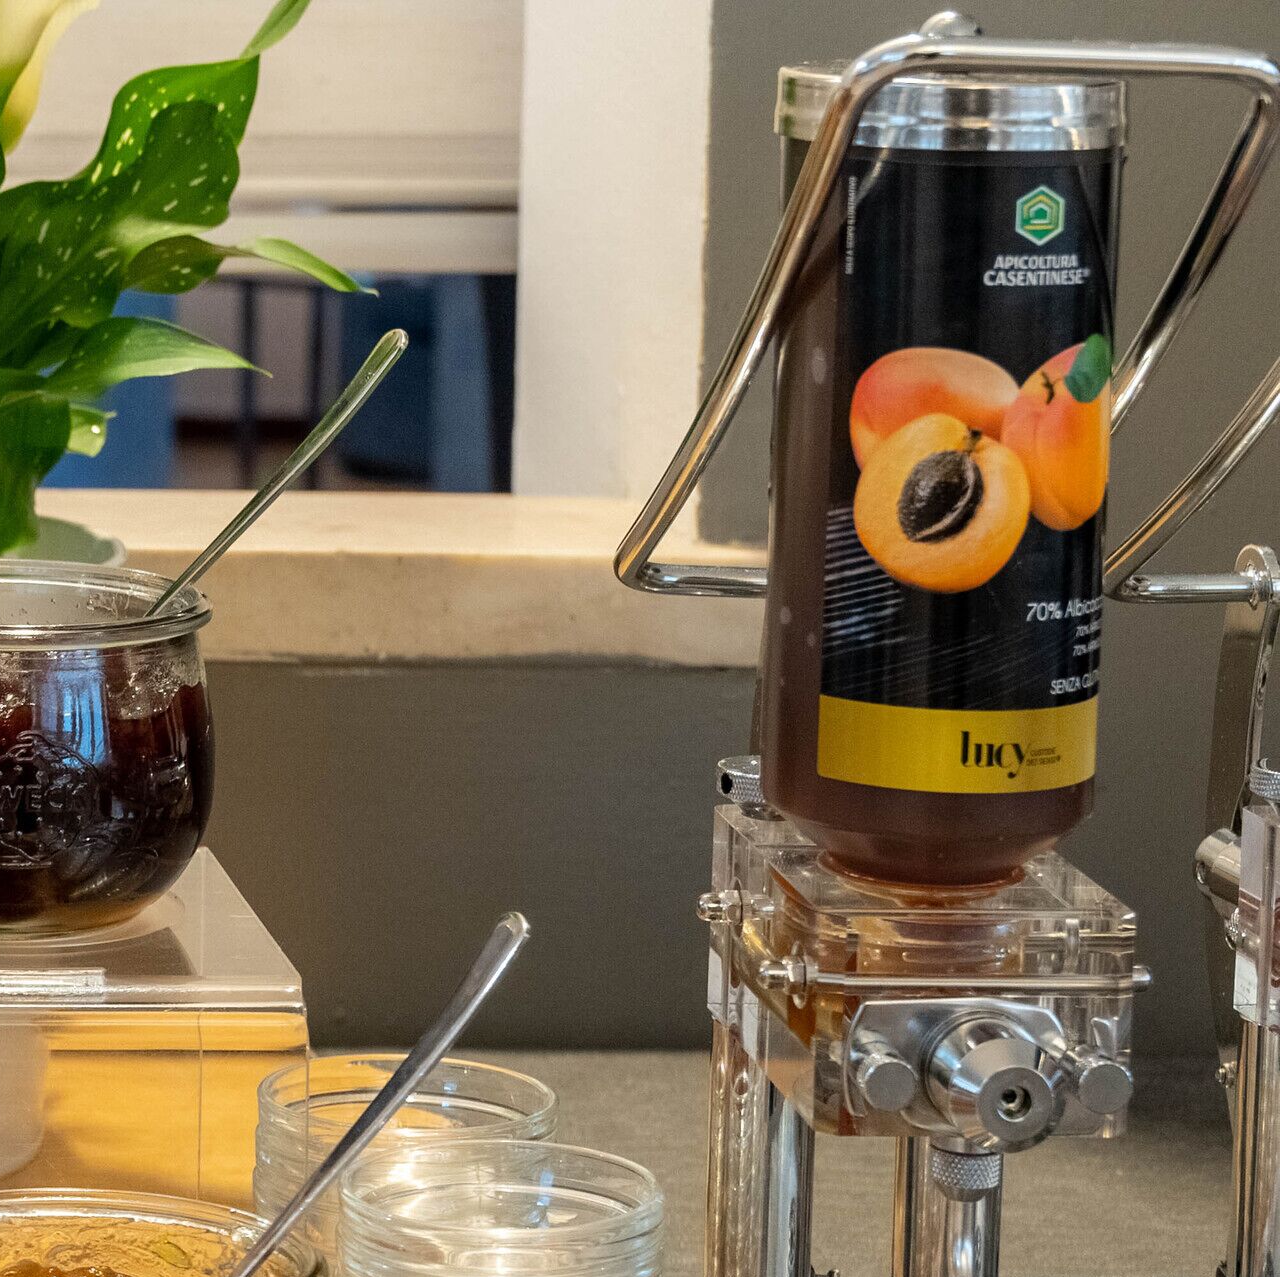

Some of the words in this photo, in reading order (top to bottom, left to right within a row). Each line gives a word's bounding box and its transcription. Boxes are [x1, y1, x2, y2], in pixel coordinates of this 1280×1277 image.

[993, 254, 1079, 270] APICOLTURA
[1026, 600, 1063, 622] 70%
[1049, 676, 1081, 695] SENZA
[960, 731, 1028, 779] lucy
